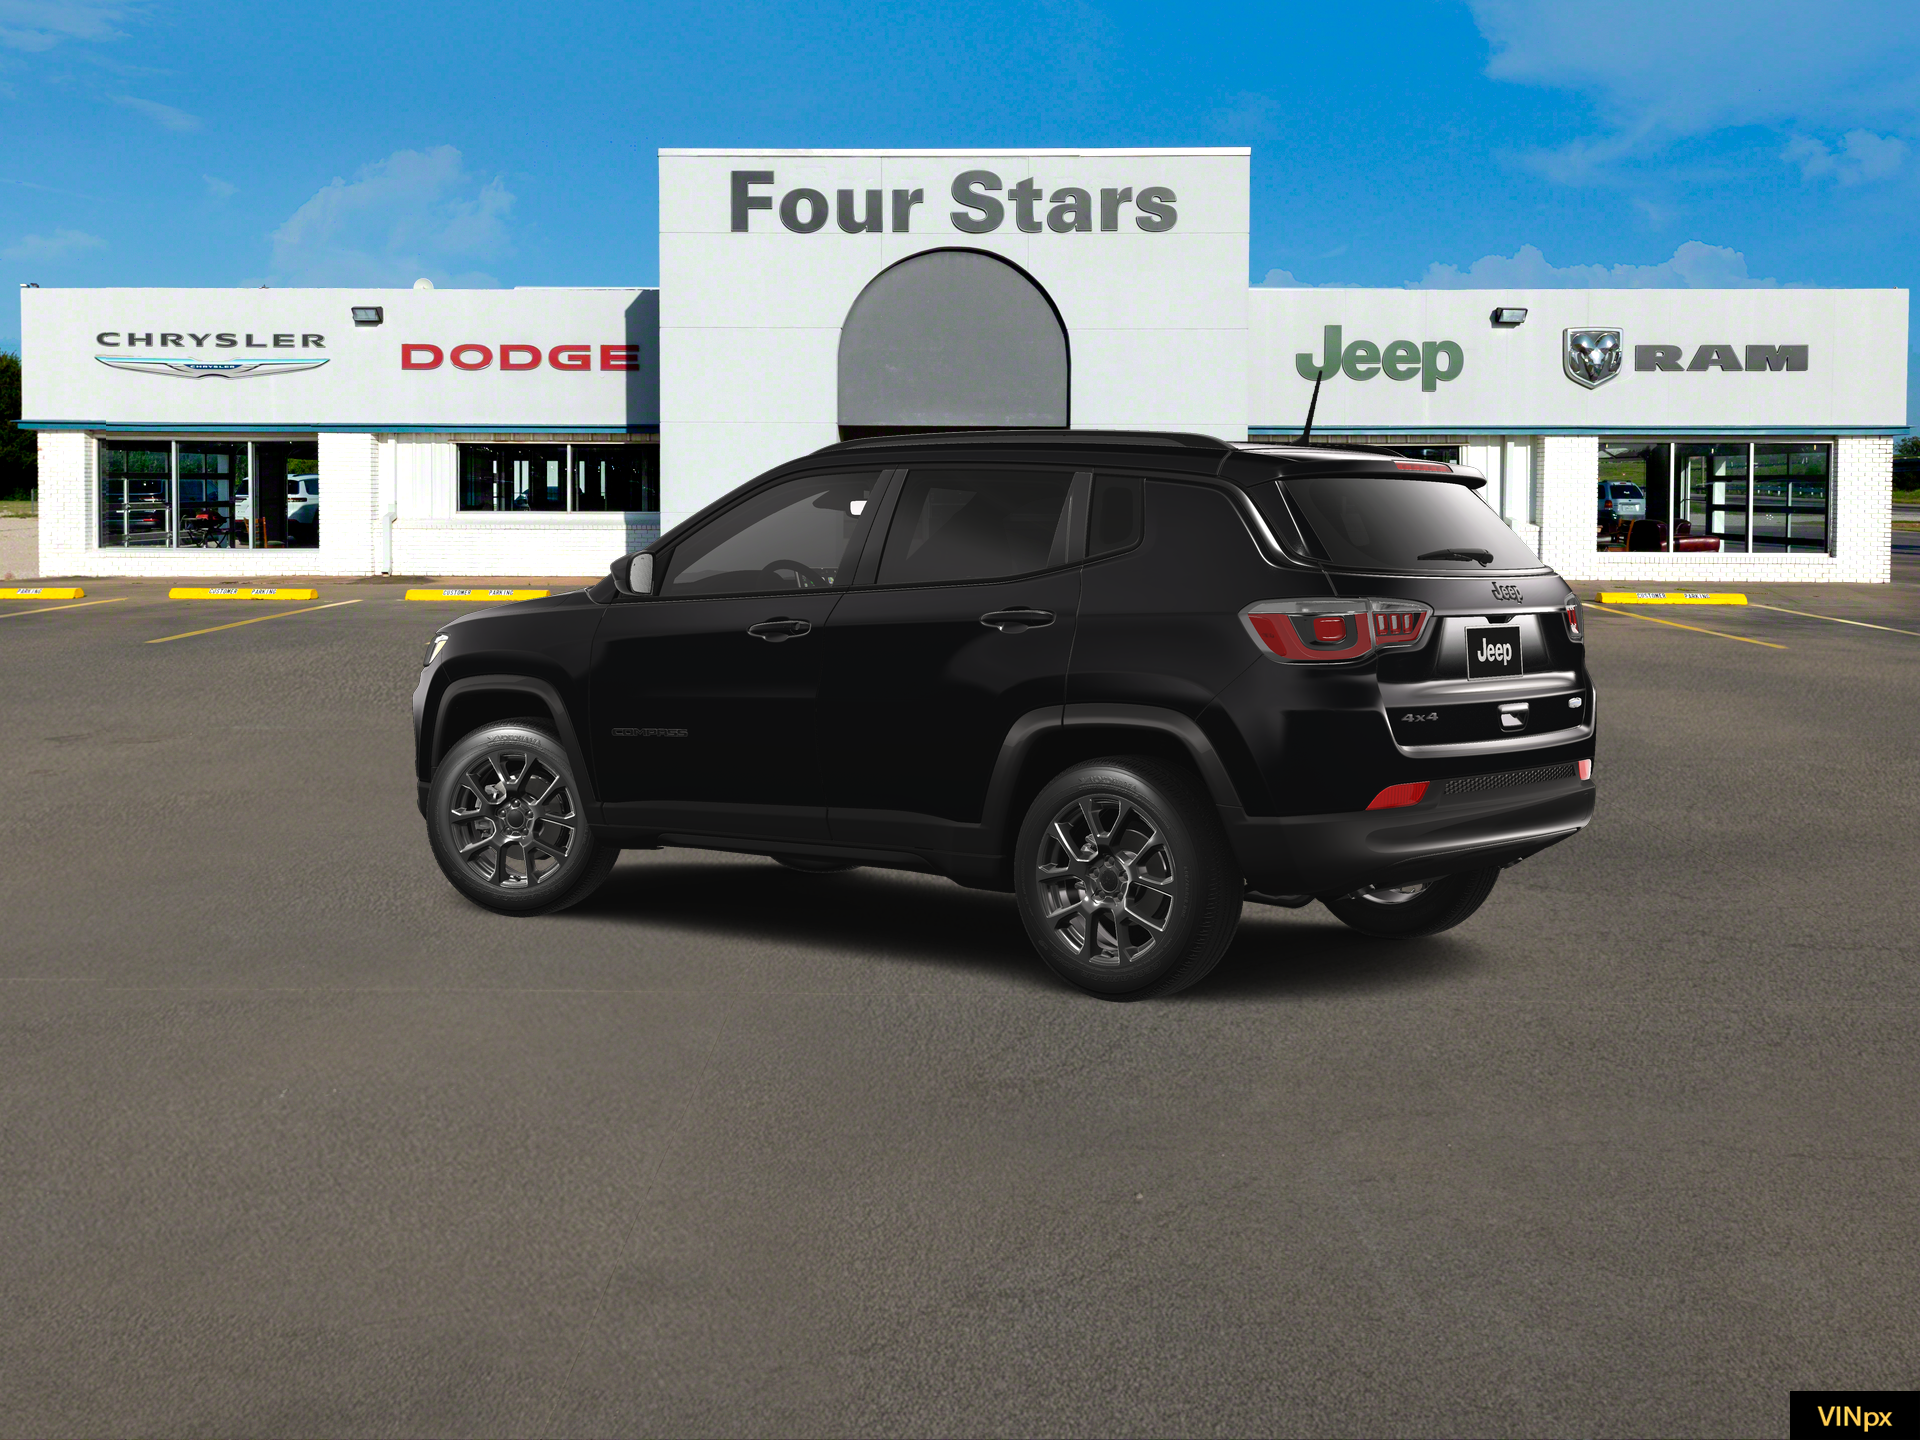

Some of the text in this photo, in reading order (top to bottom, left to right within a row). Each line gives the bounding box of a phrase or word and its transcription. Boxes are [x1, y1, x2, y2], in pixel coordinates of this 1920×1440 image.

[730, 169, 1179, 233] Four Stars
[96, 331, 327, 348] CHRYSLER
[401, 343, 641, 372] DODGE
[1295, 324, 1465, 393] Jeep
[1634, 344, 1809, 372] RAM
[1491, 581, 1524, 604] Jeep
[1476, 637, 1513, 666] Jeep
[1401, 711, 1439, 723] 4x4
[611, 727, 689, 738] COMPASS
